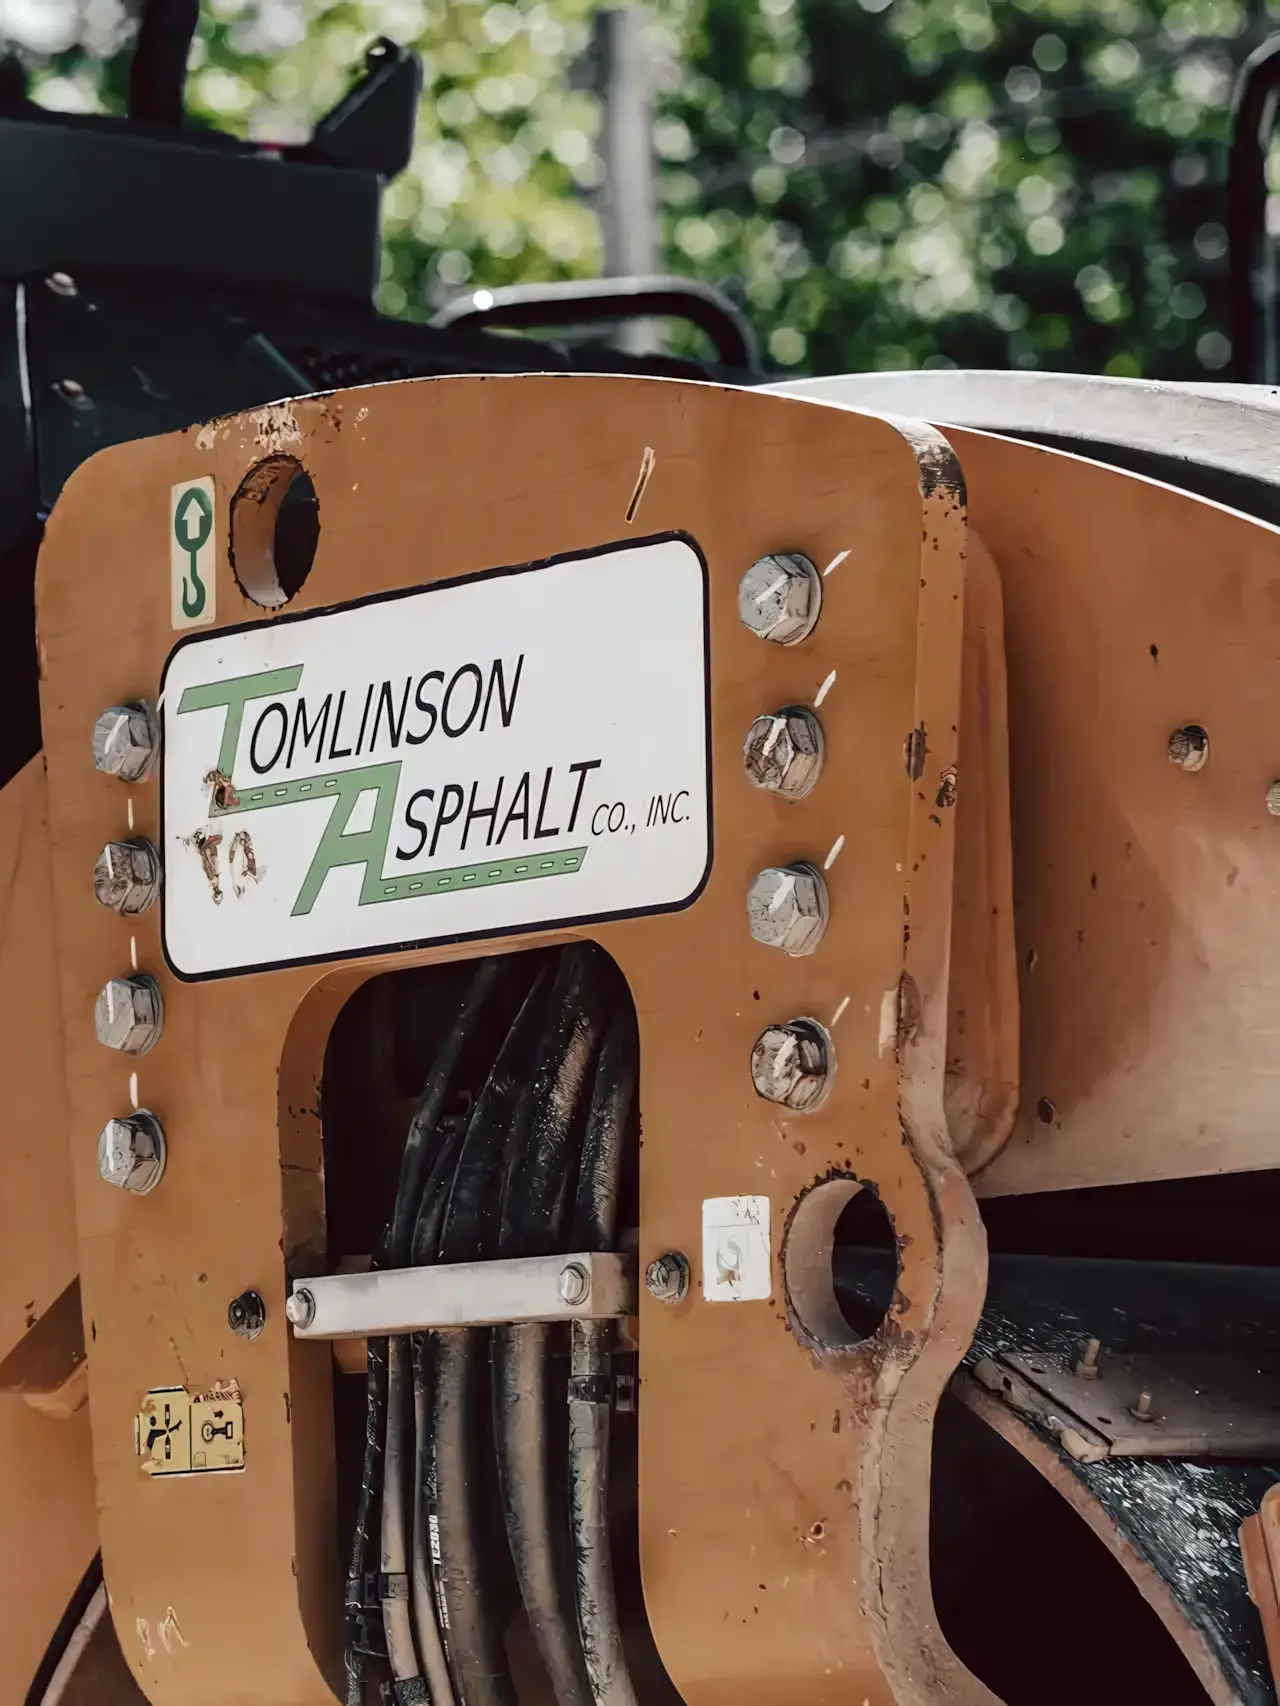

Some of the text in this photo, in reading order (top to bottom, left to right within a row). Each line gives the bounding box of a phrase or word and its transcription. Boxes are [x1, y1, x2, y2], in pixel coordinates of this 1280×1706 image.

[177, 655, 524, 817] TOMLINSON
[291, 759, 602, 916] ASPHALT
[646, 791, 690, 828] INC.
